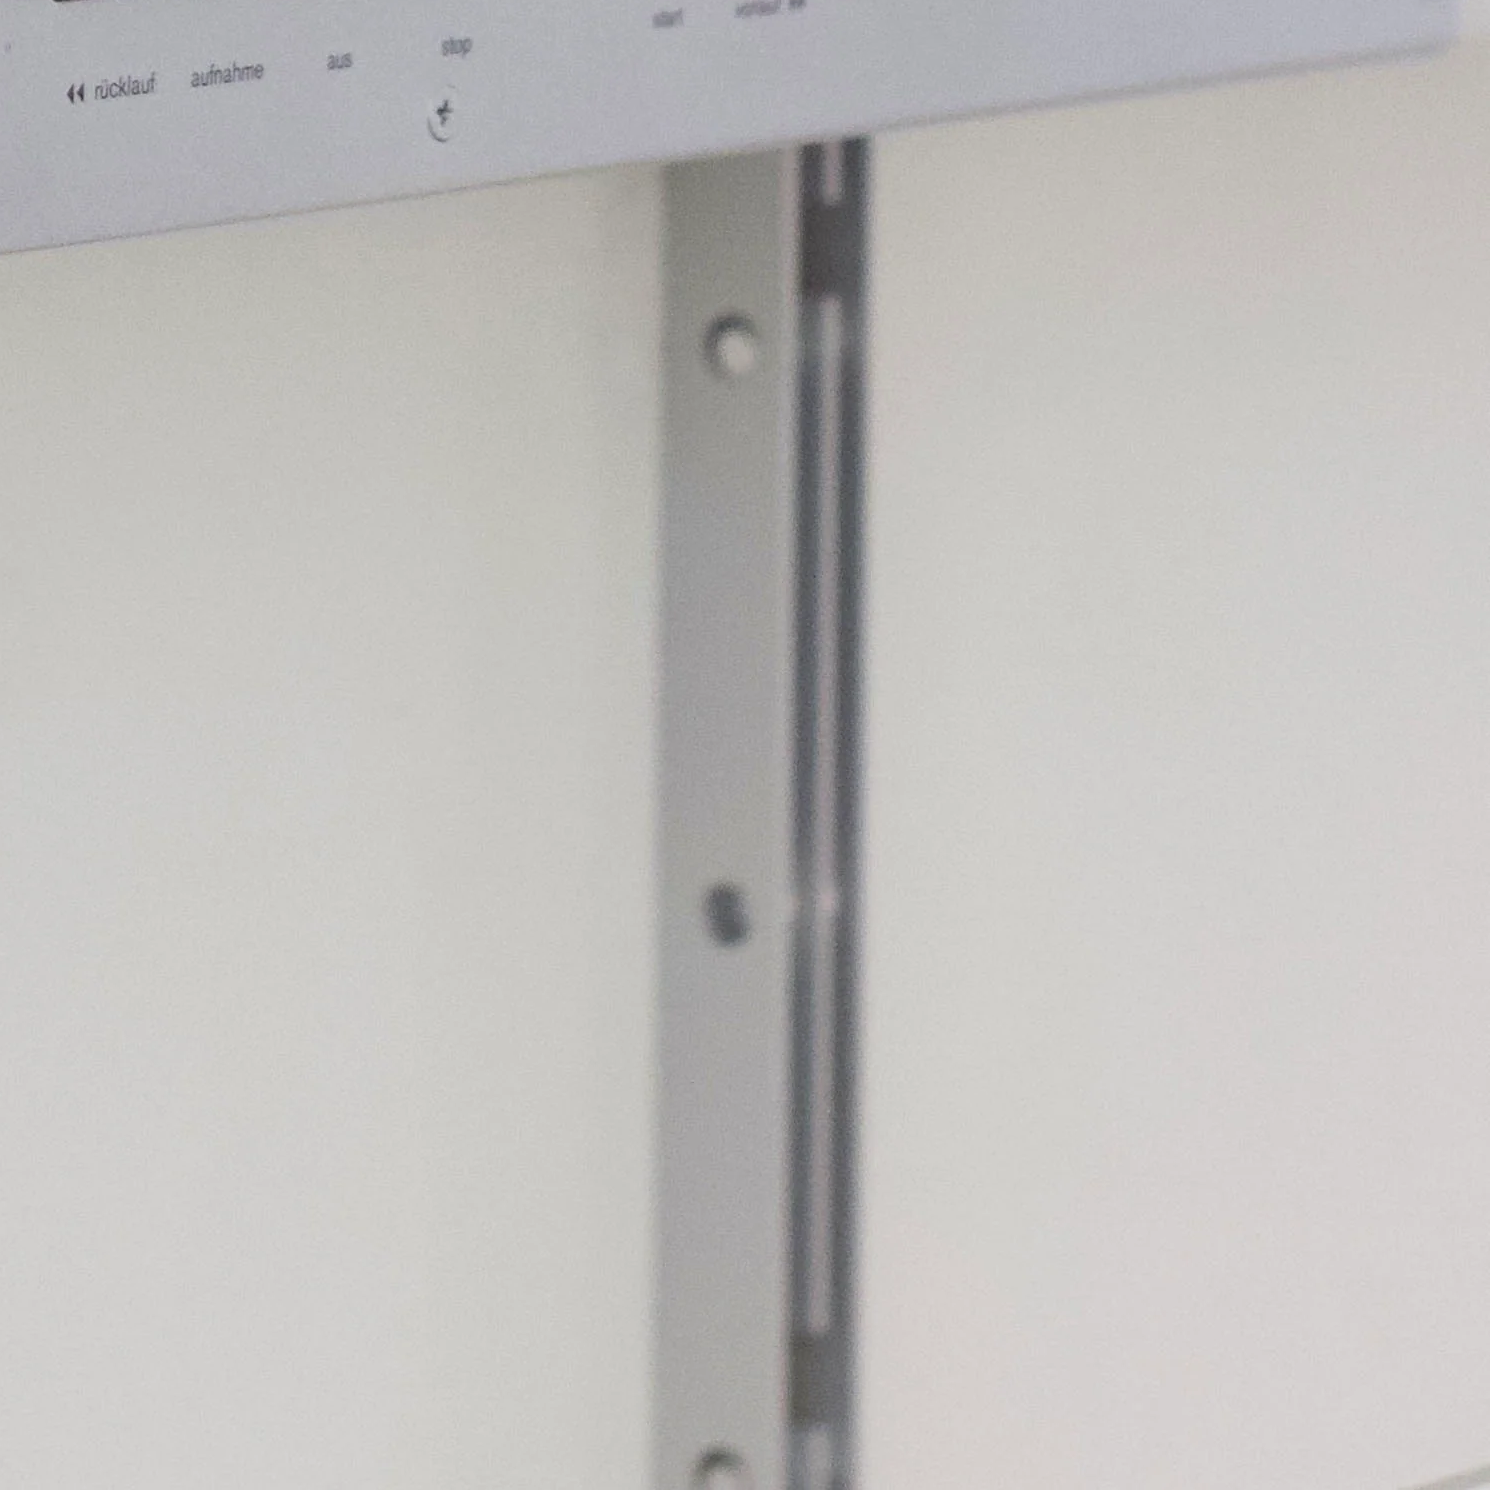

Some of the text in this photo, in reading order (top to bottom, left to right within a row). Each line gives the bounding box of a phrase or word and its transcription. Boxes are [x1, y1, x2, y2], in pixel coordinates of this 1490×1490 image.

[442, 37, 472, 56] stop
[327, 52, 352, 69] aus
[95, 71, 157, 100] rücklauf
[191, 61, 264, 88] aufnahme
